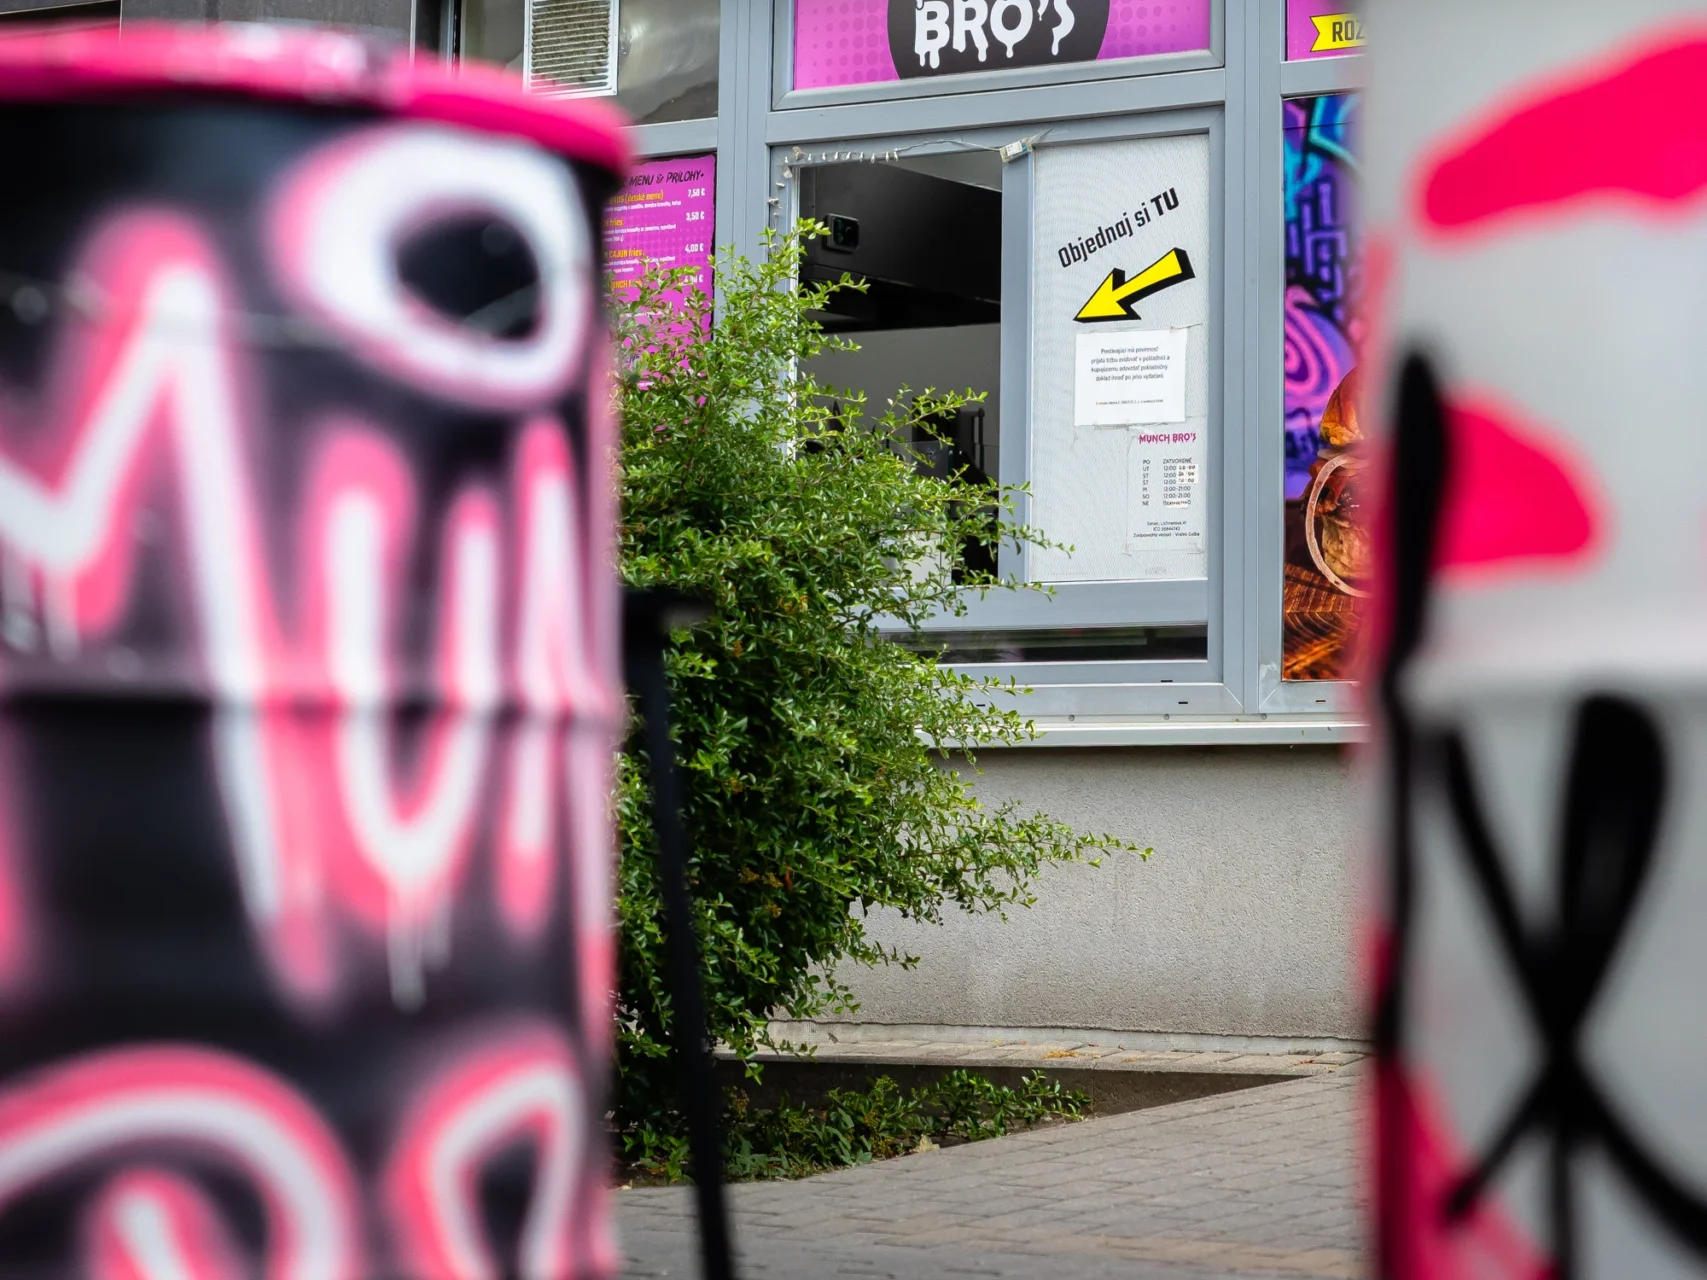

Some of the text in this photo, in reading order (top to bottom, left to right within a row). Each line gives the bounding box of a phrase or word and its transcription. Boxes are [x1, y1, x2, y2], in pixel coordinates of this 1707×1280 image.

[629, 175, 654, 187] MENU
[1058, 187, 1180, 268] Objednaj si TU
[1139, 432, 1197, 444] MUNCH BRO'S
